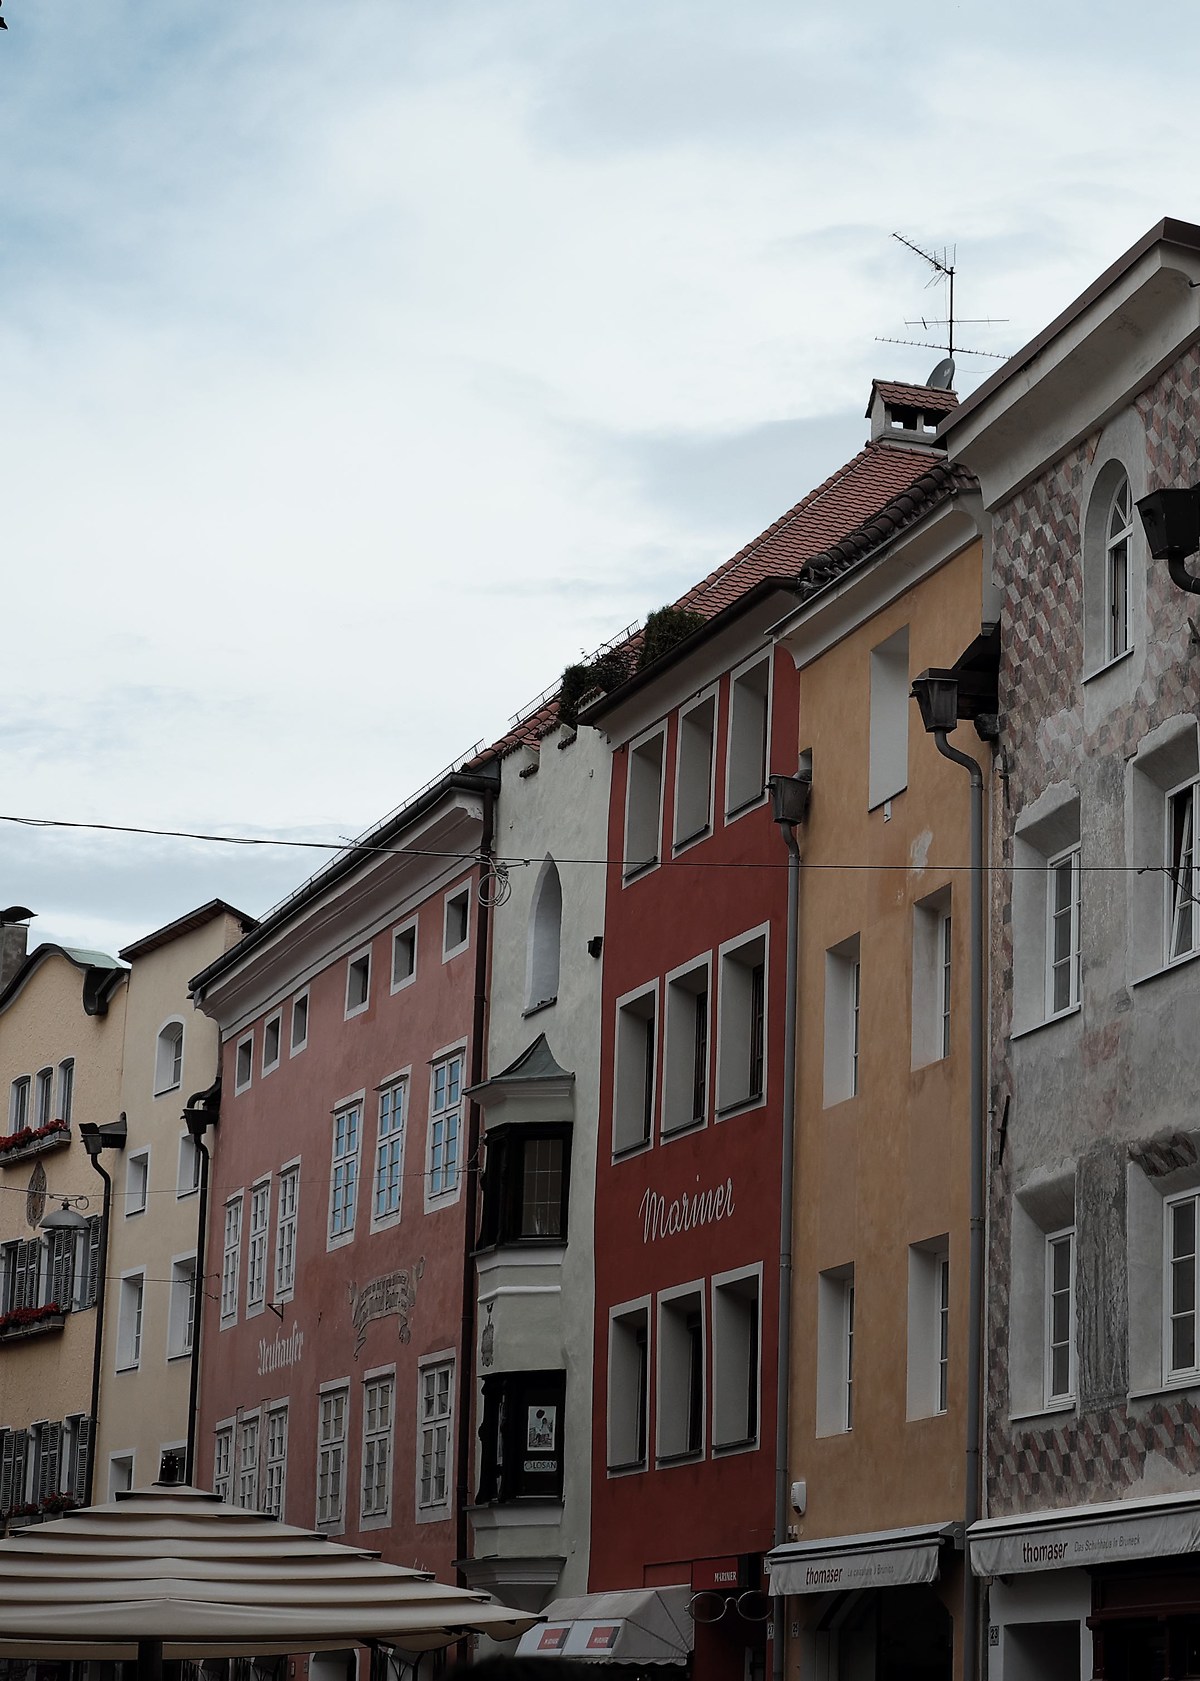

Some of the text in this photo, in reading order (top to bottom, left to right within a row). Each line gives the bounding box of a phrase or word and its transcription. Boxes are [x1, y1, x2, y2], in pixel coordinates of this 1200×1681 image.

[638, 1174, 735, 1244] Mariner
[1022, 1541, 1068, 1563] thomaser
[805, 1566, 843, 1585] thomaser
[990, 1628, 998, 1640] 23
